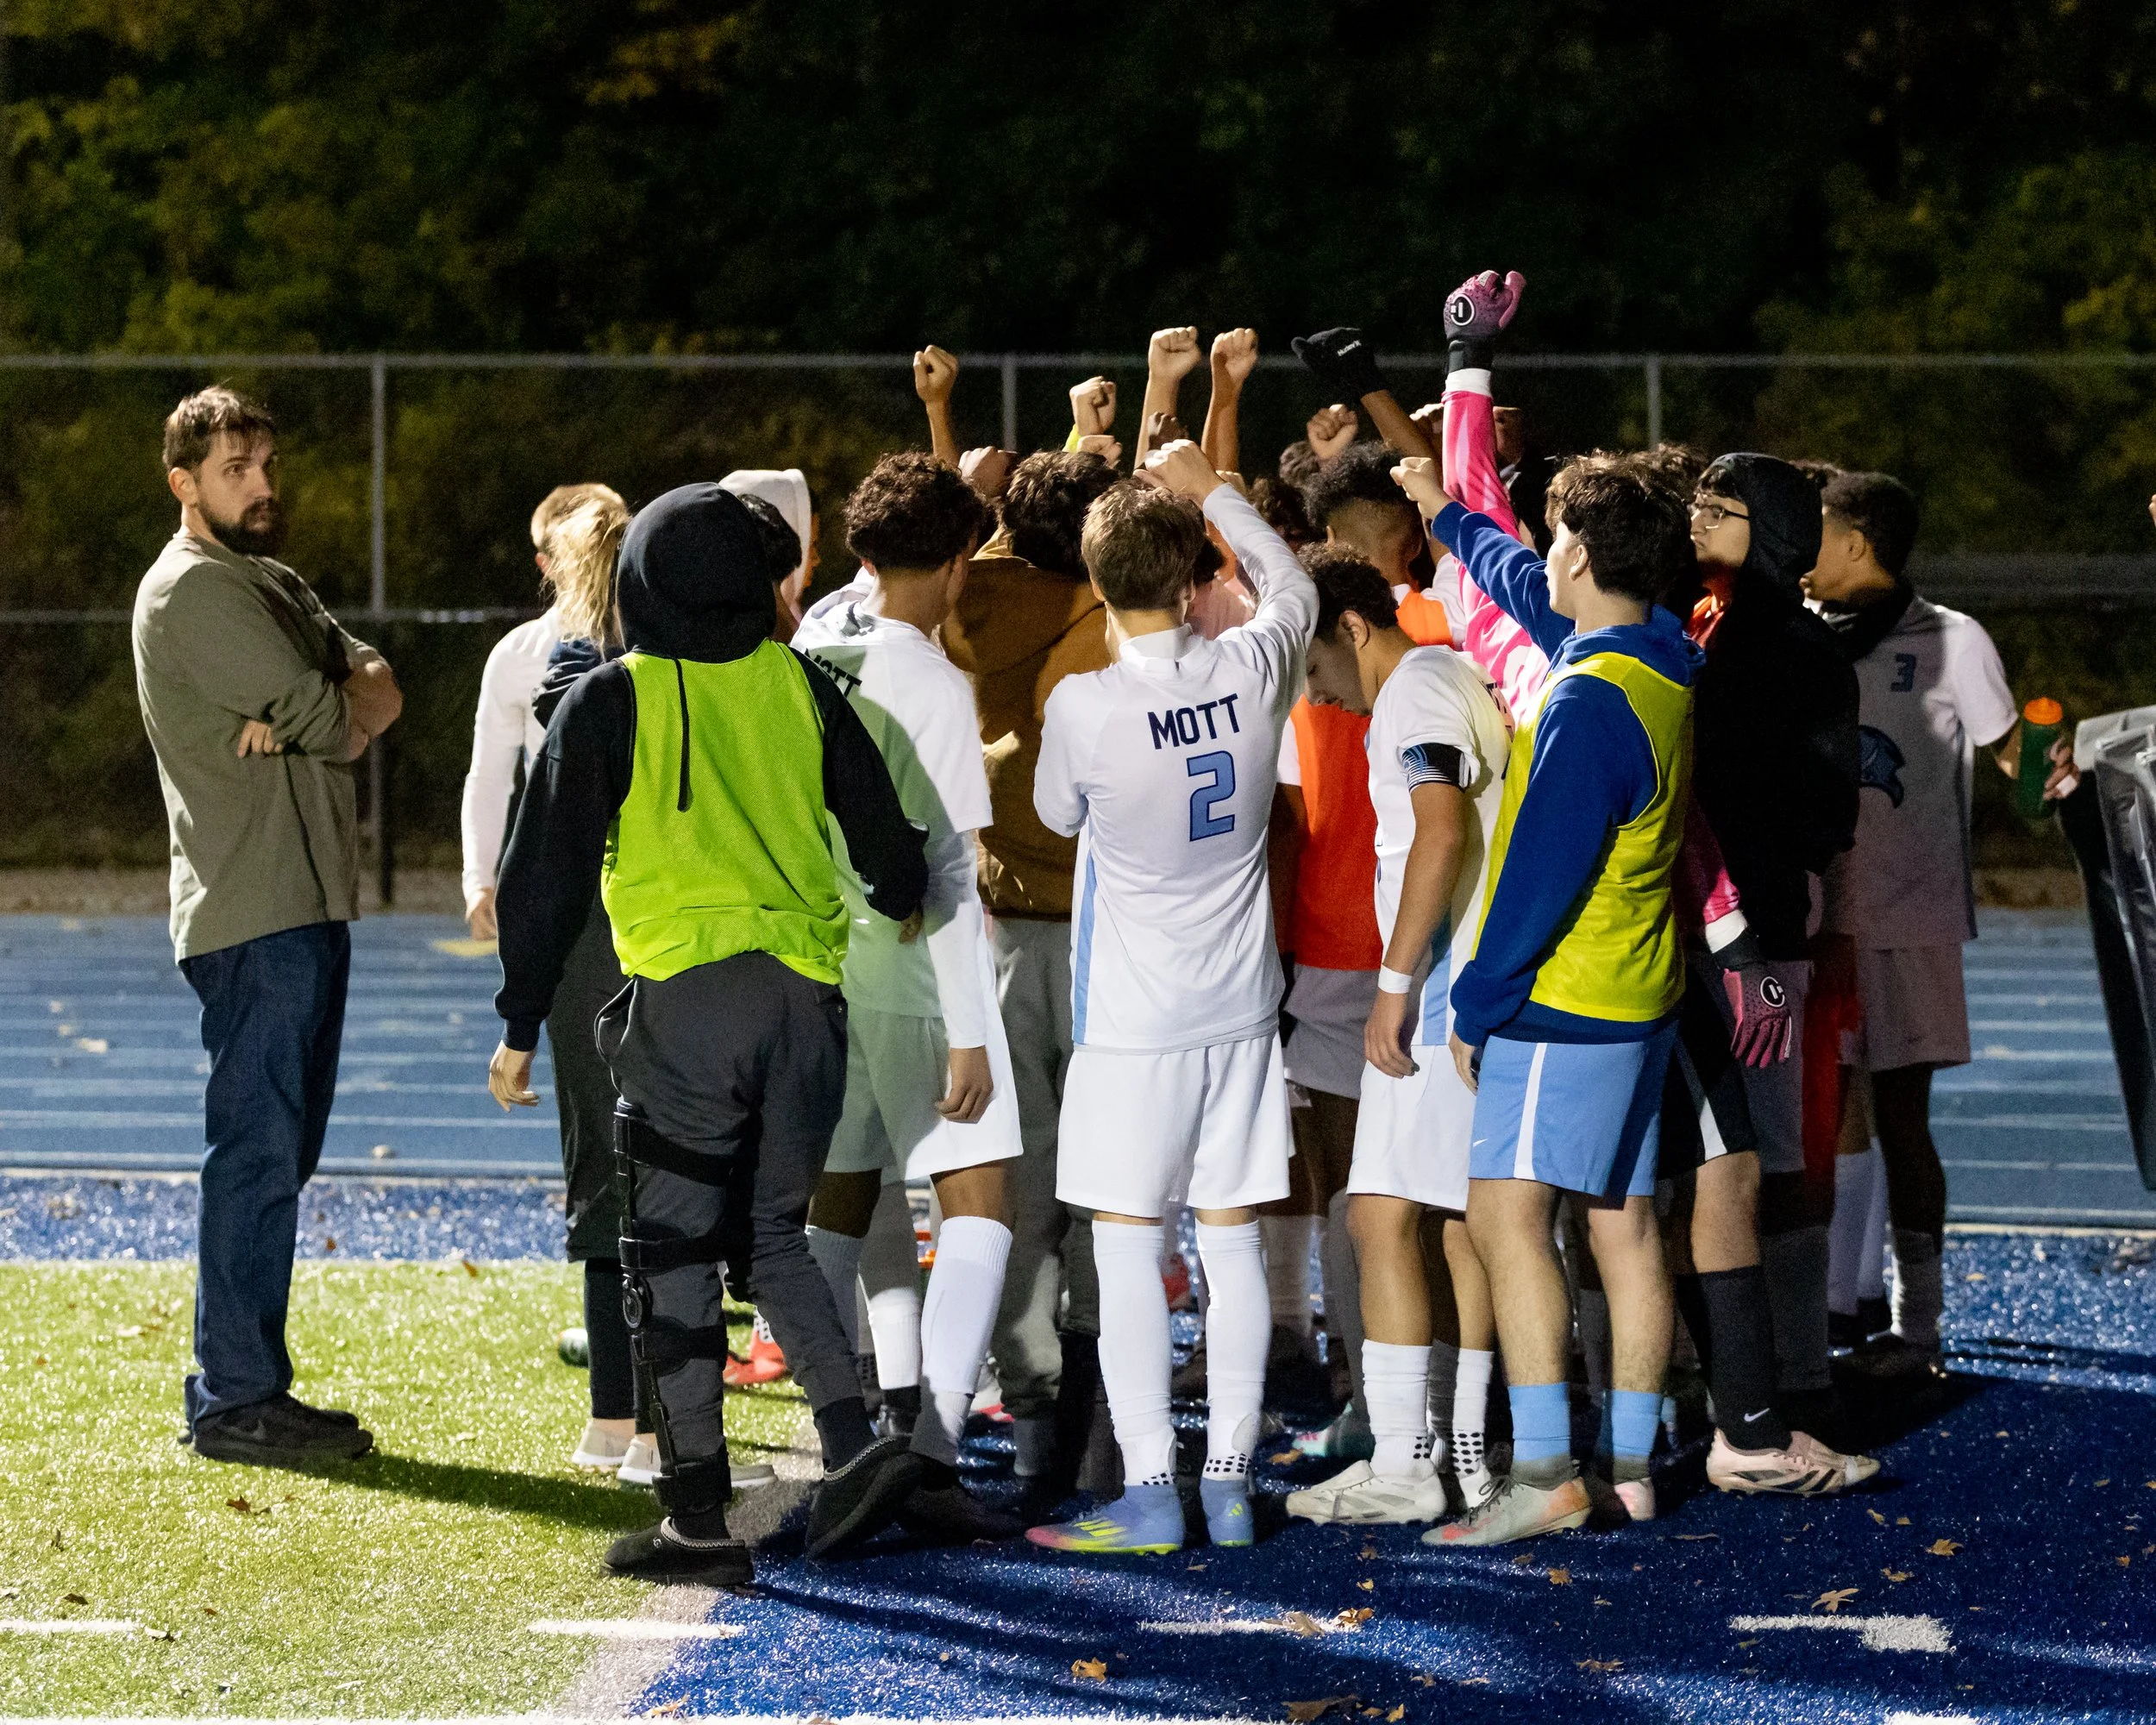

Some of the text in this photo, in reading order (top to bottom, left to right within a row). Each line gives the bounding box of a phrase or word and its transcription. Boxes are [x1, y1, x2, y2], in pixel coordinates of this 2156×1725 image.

[1890, 653, 1917, 692] 3
[1147, 693, 1240, 750] MOTT
[1186, 750, 1237, 842] 2
